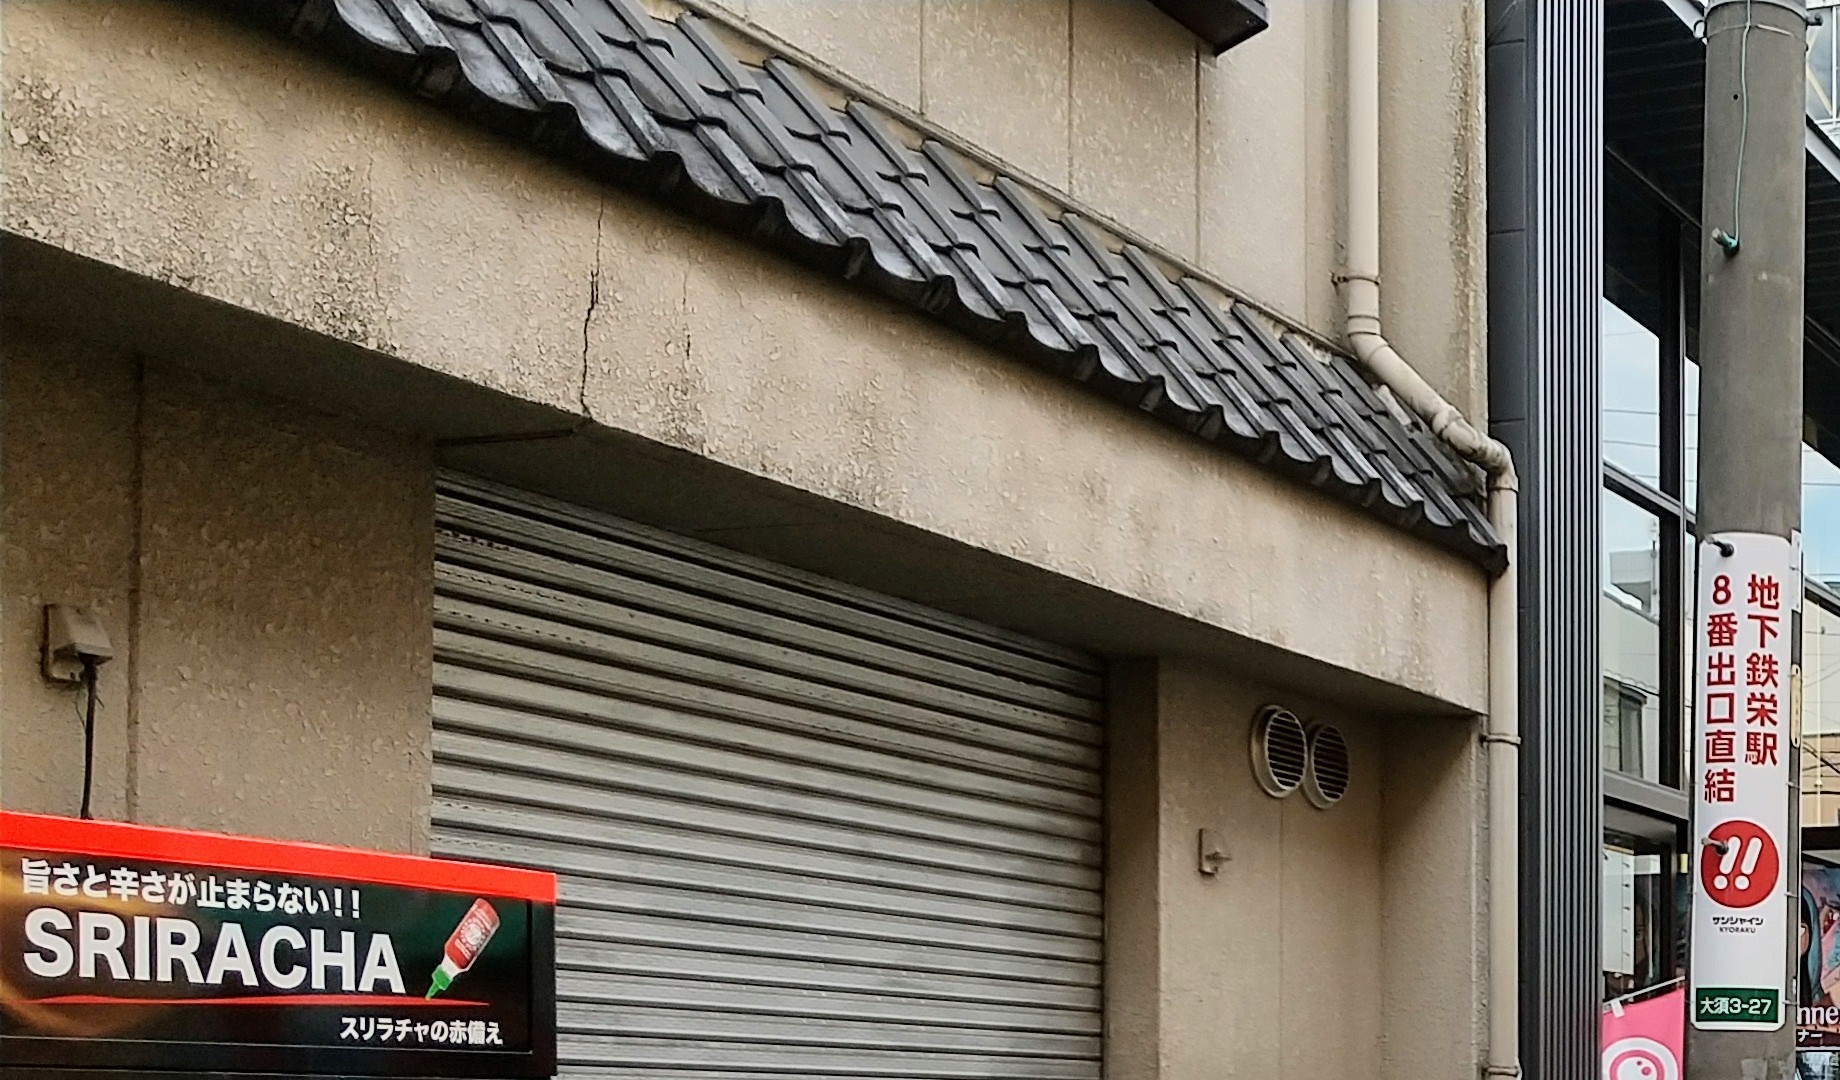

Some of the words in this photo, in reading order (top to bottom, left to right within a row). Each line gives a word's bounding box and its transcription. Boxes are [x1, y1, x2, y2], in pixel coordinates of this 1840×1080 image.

[1704, 574, 1738, 804] 8番出口直結
[1744, 574, 1780, 767] 地下鉄栄駅
[21, 858, 361, 918] 旨さと辛さが止まらない!!
[1713, 917, 1764, 925] サンシャイン
[1719, 926, 1756, 934] KYORAKU
[23, 907, 406, 994] SRIRACHA
[1700, 996, 1772, 1015] 大須3-27
[340, 1016, 503, 1045] スリラチャの赤備え
